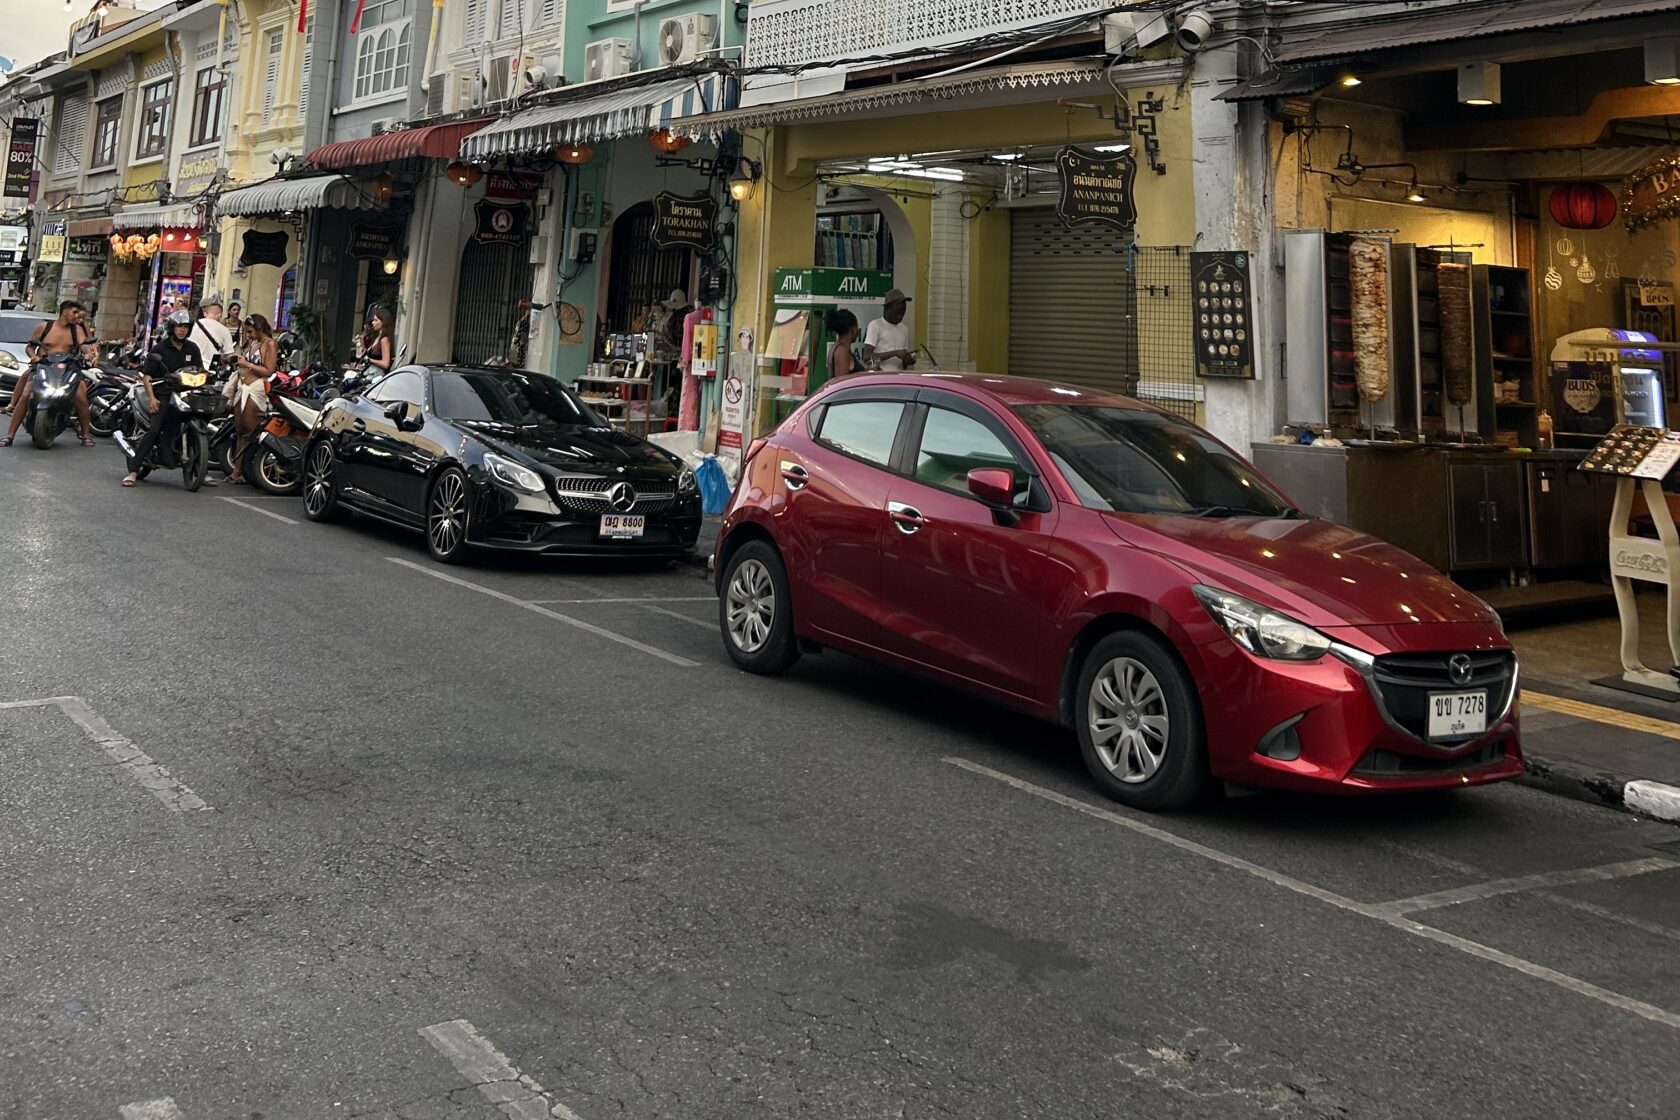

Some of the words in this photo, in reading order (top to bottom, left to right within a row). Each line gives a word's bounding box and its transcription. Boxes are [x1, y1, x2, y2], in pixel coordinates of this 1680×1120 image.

[10, 151, 33, 162] 80%
[1073, 189, 1123, 202] ANANPANICH
[662, 216, 709, 229] TORAKHAN
[781, 275, 802, 291] ATM
[838, 276, 868, 293] ATM
[1646, 294, 1669, 303] OPEN
[1568, 380, 1596, 391] BUDS
[622, 516, 643, 527] 8800
[1435, 696, 1452, 717] ขข
[1458, 695, 1484, 715] 7278
